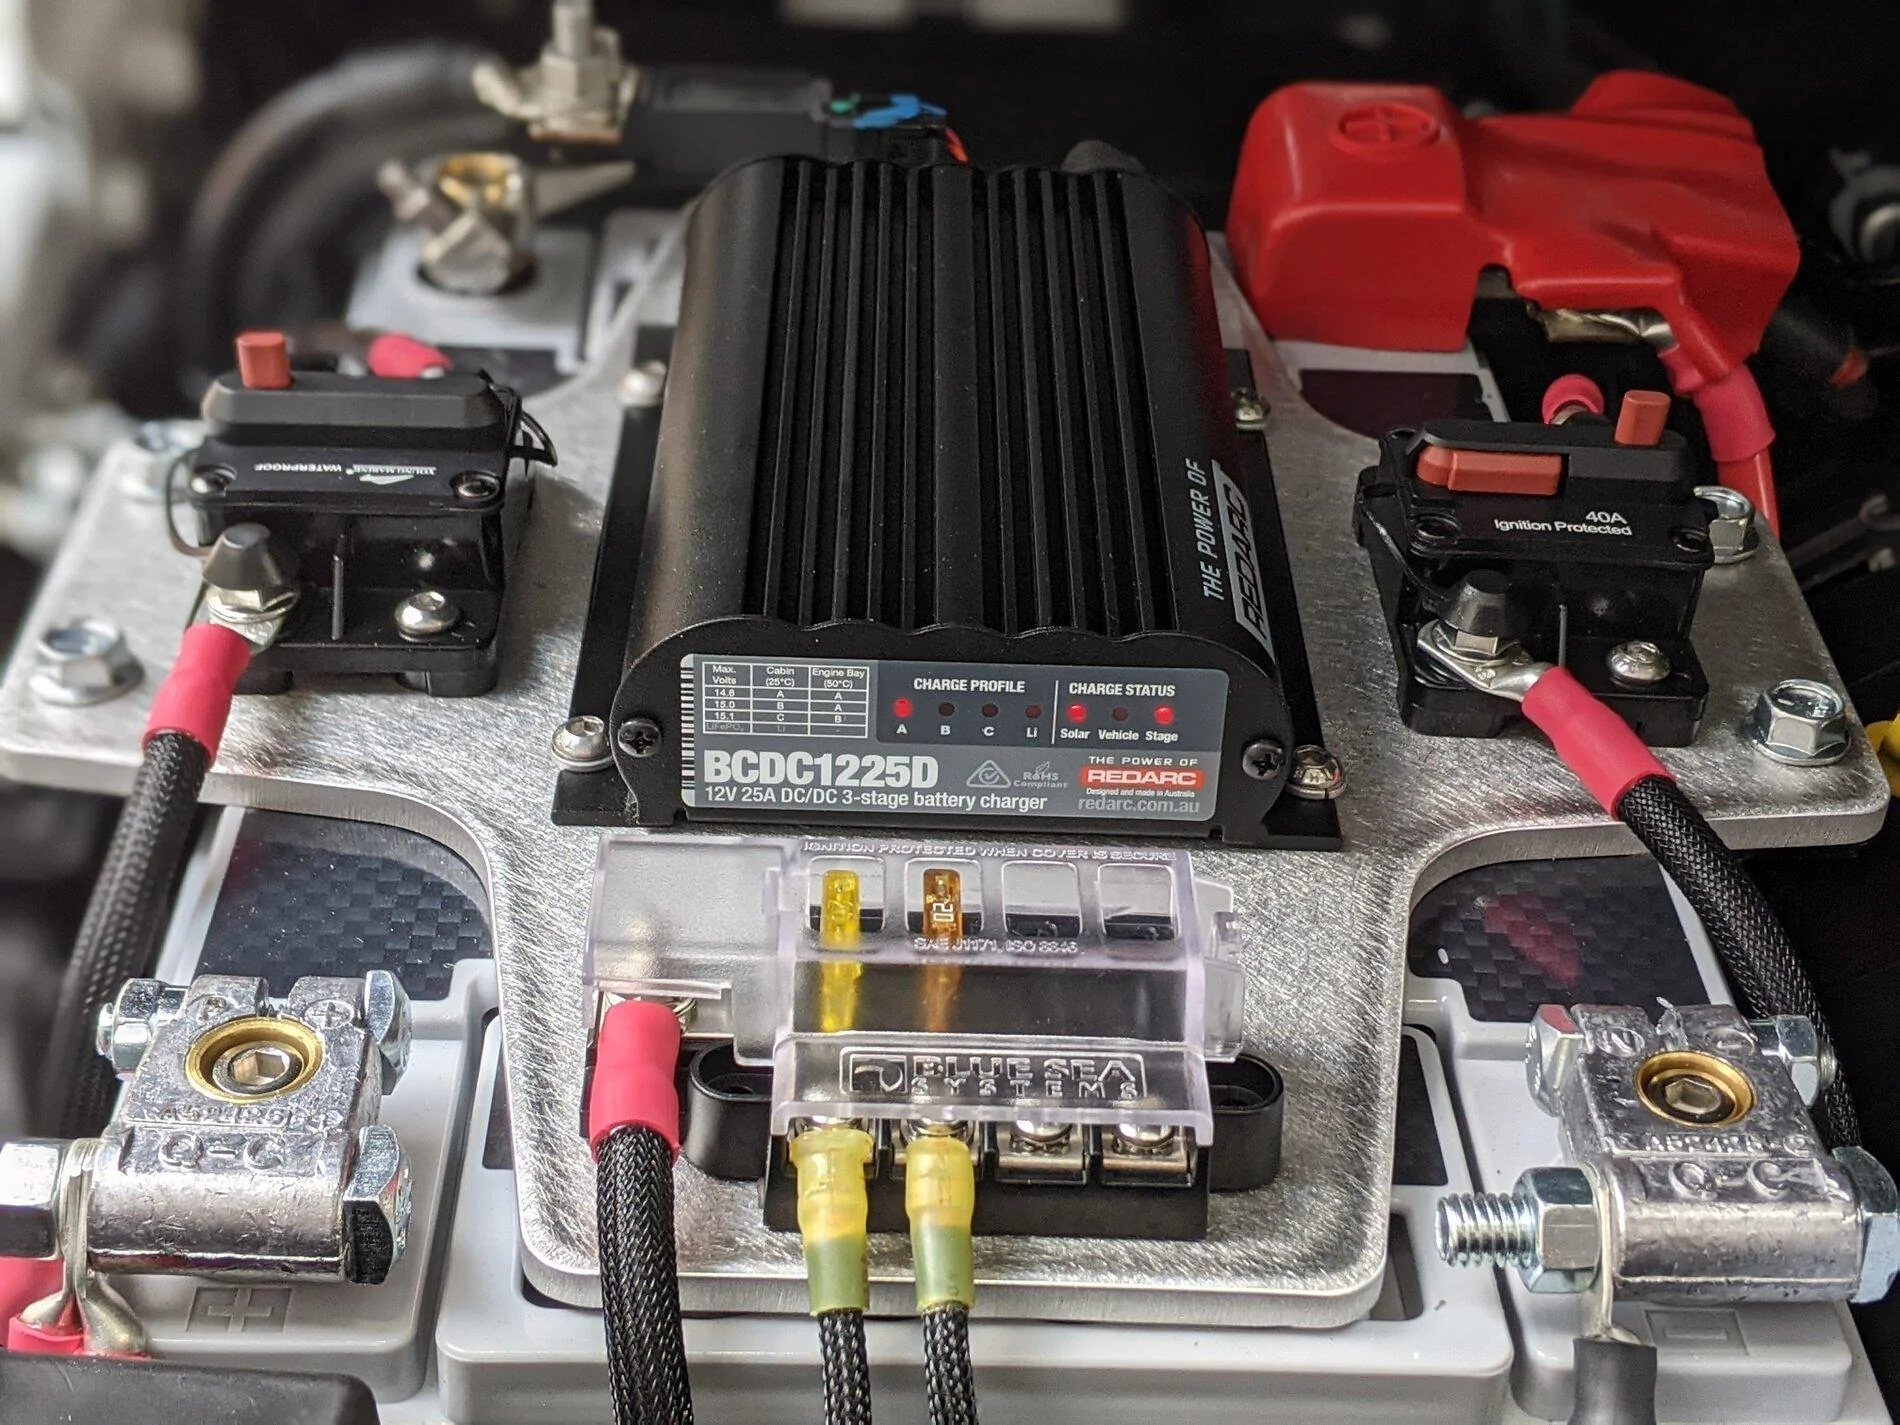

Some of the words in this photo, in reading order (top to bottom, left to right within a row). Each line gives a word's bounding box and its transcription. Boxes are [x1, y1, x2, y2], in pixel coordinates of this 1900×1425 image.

[254, 463, 342, 472] WATERPROOF
[1185, 457, 1207, 486] OF
[1585, 510, 1628, 524] 40A
[1190, 488, 1218, 559] POWER
[1493, 518, 1553, 532] Ignition
[1553, 520, 1632, 536] Protected
[1223, 483, 1267, 641] REDARC
[1200, 560, 1225, 600] THE
[712, 664, 737, 674] Max.
[766, 666, 795, 676] Cabin
[812, 668, 845, 679] Engine
[846, 668, 865, 679] Bay
[712, 675, 737, 685] Volts
[913, 677, 968, 692] CHARGE
[970, 679, 1026, 693] PROFILE
[776, 690, 785, 698] A
[1068, 682, 1123, 696] CHARGE
[1125, 684, 1176, 697] STATUS
[834, 692, 843, 700] A
[714, 700, 736, 709] 15.0
[776, 702, 785, 710] B
[834, 703, 843, 712] A
[714, 712, 735, 721] 15.1
[776, 713, 785, 722] C
[834, 715, 842, 723] B
[896, 724, 908, 735] A
[940, 725, 951, 735] B
[984, 726, 995, 736] C
[1026, 727, 1038, 738] Li
[1060, 728, 1091, 740] Solar
[1098, 729, 1140, 741] Vehicle
[1145, 730, 1178, 743] Stage
[1088, 755, 1115, 764] THE
[1121, 756, 1173, 766] POWER
[1179, 758, 1198, 766] OF
[703, 749, 939, 789] BCDC1225D
[1087, 769, 1197, 786] REDARC
[1013, 780, 1069, 789] Compliant
[1086, 787, 1119, 796] Designed
[1120, 787, 1134, 796] and
[1135, 788, 1155, 797] made
[1164, 789, 1195, 798] Australia
[705, 786, 737, 802] 12V
[741, 787, 777, 803] 25A
[781, 788, 838, 804] DC/DC
[842, 790, 909, 809] 3-stage
[913, 790, 975, 812] battery
[980, 792, 1048, 812] charger
[1077, 796, 1200, 813] redarc.com.au
[878, 844, 977, 857] PROTECTED
[979, 846, 1028, 858] WHEN
[1031, 848, 1089, 859] COVER
[911, 1054, 1033, 1079] BLUE
[1043, 1057, 1137, 1083] SEA
